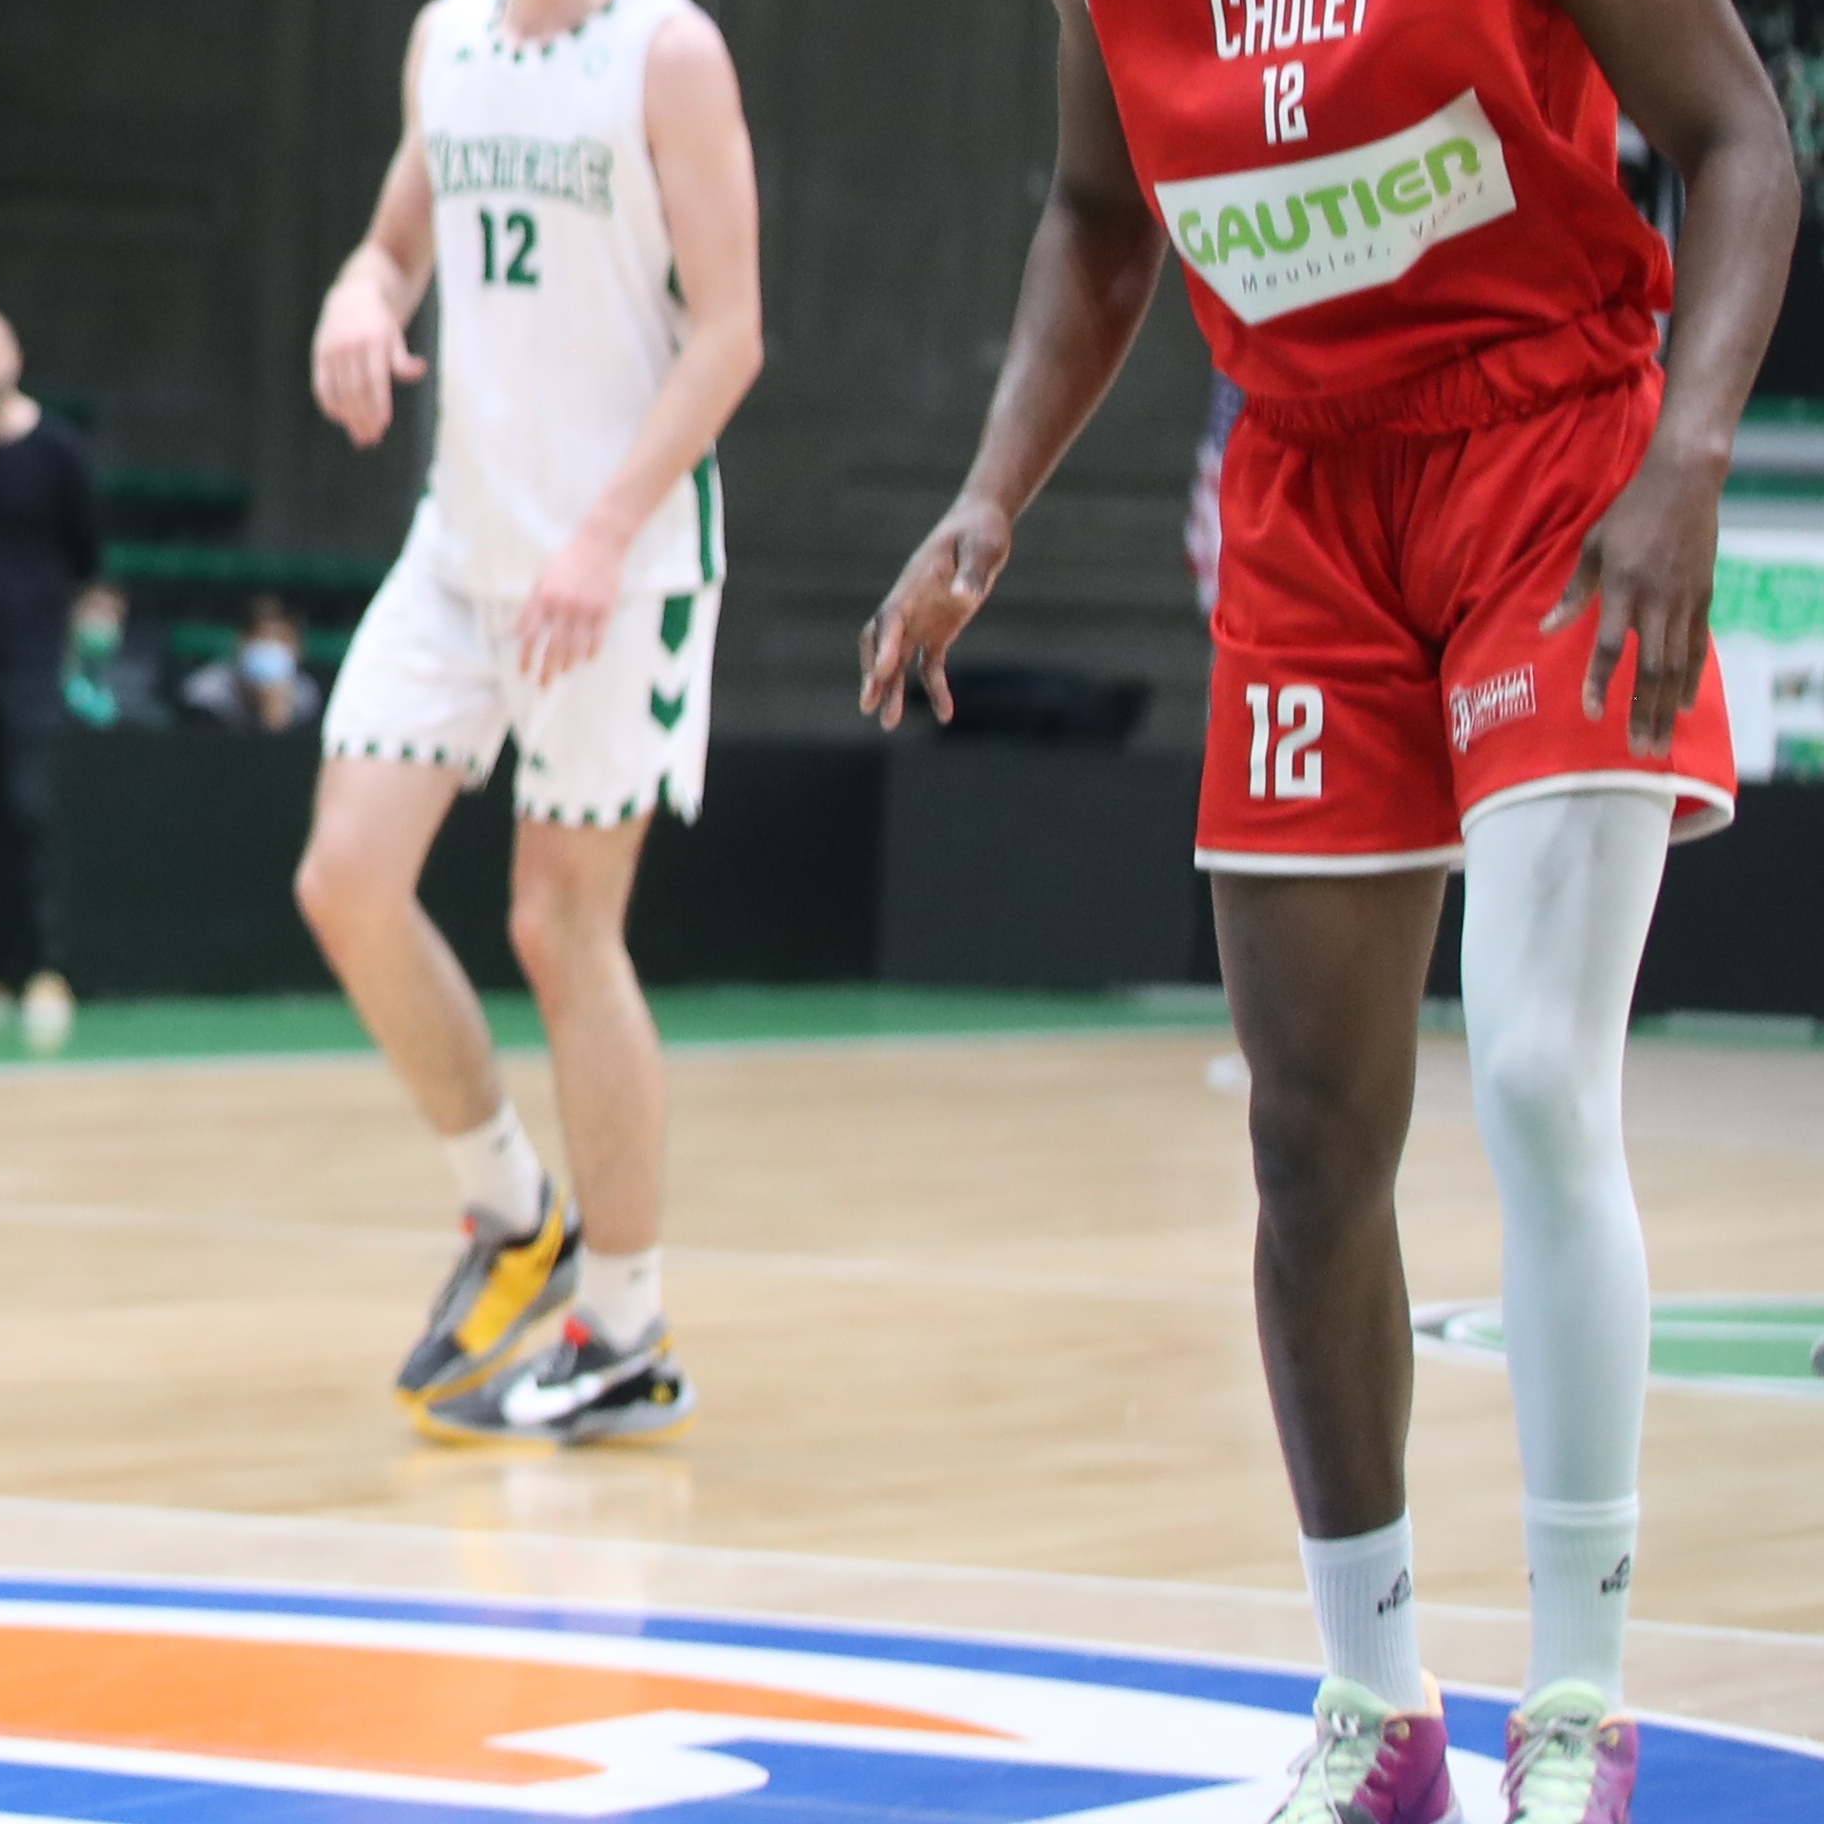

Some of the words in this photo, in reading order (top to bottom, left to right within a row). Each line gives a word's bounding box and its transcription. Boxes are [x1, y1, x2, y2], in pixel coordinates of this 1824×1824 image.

[1263, 60, 1309, 145] 12
[479, 208, 539, 286] 12
[1177, 136, 1483, 266] GAUTIER
[1246, 683, 1324, 799] 12
